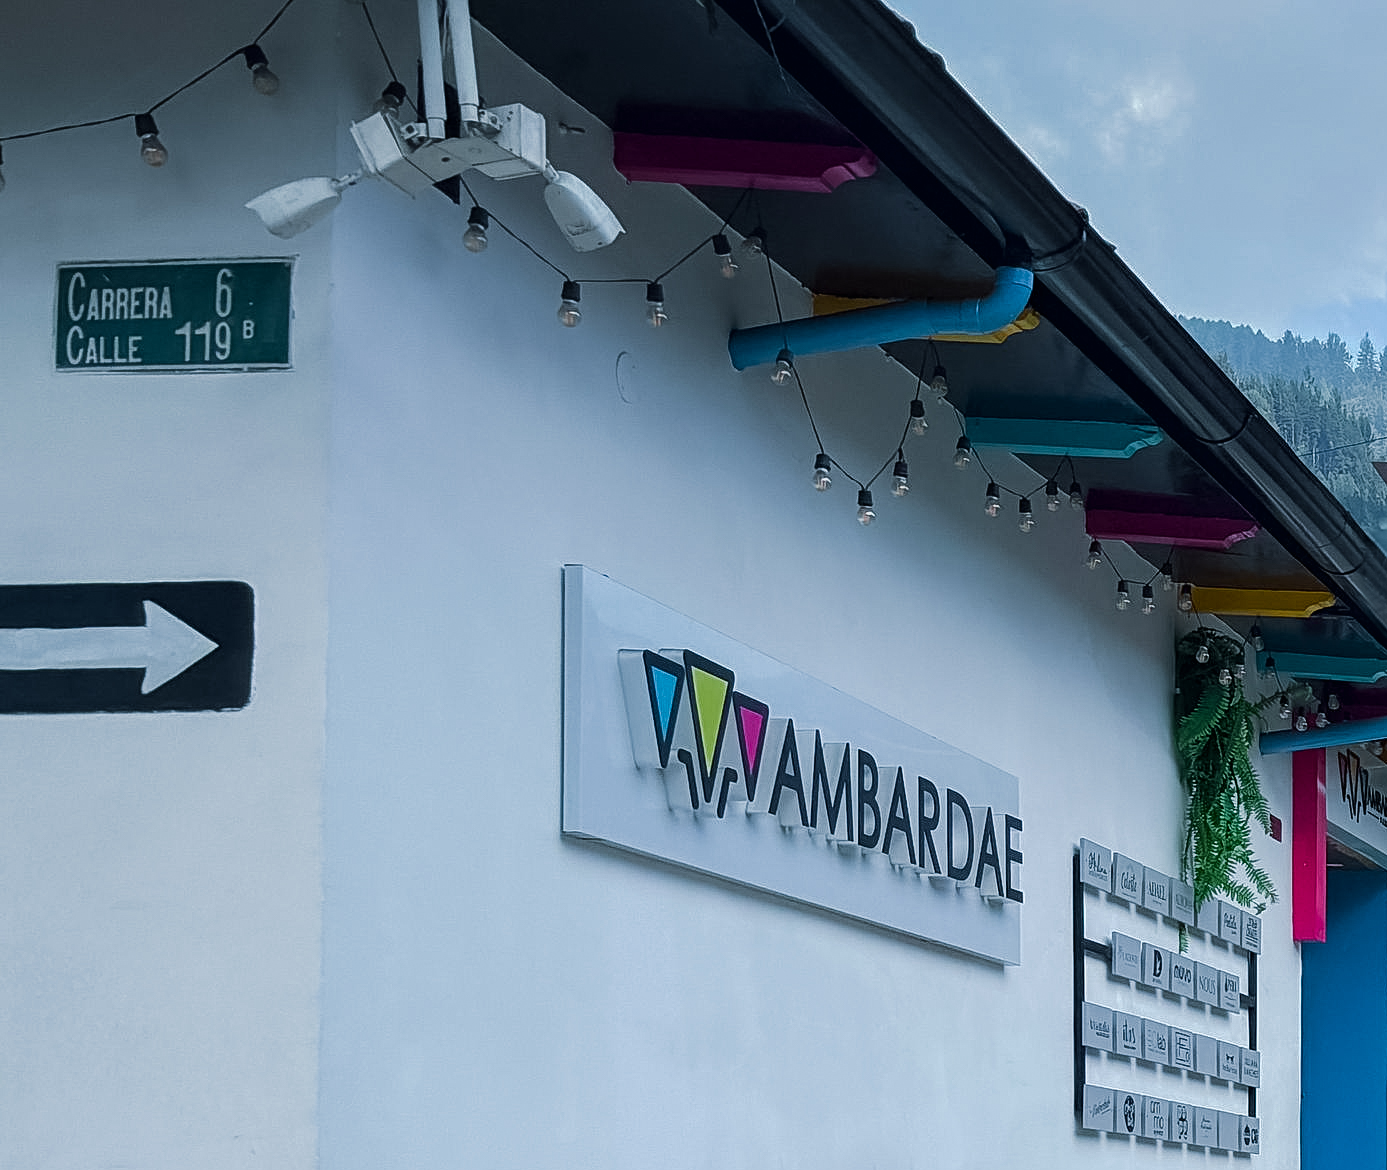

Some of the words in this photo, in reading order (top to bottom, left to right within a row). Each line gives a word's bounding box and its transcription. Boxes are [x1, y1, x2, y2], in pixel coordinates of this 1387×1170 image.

[215, 267, 233, 318] 6
[174, 320, 231, 362] 119
[242, 319, 255, 340] B
